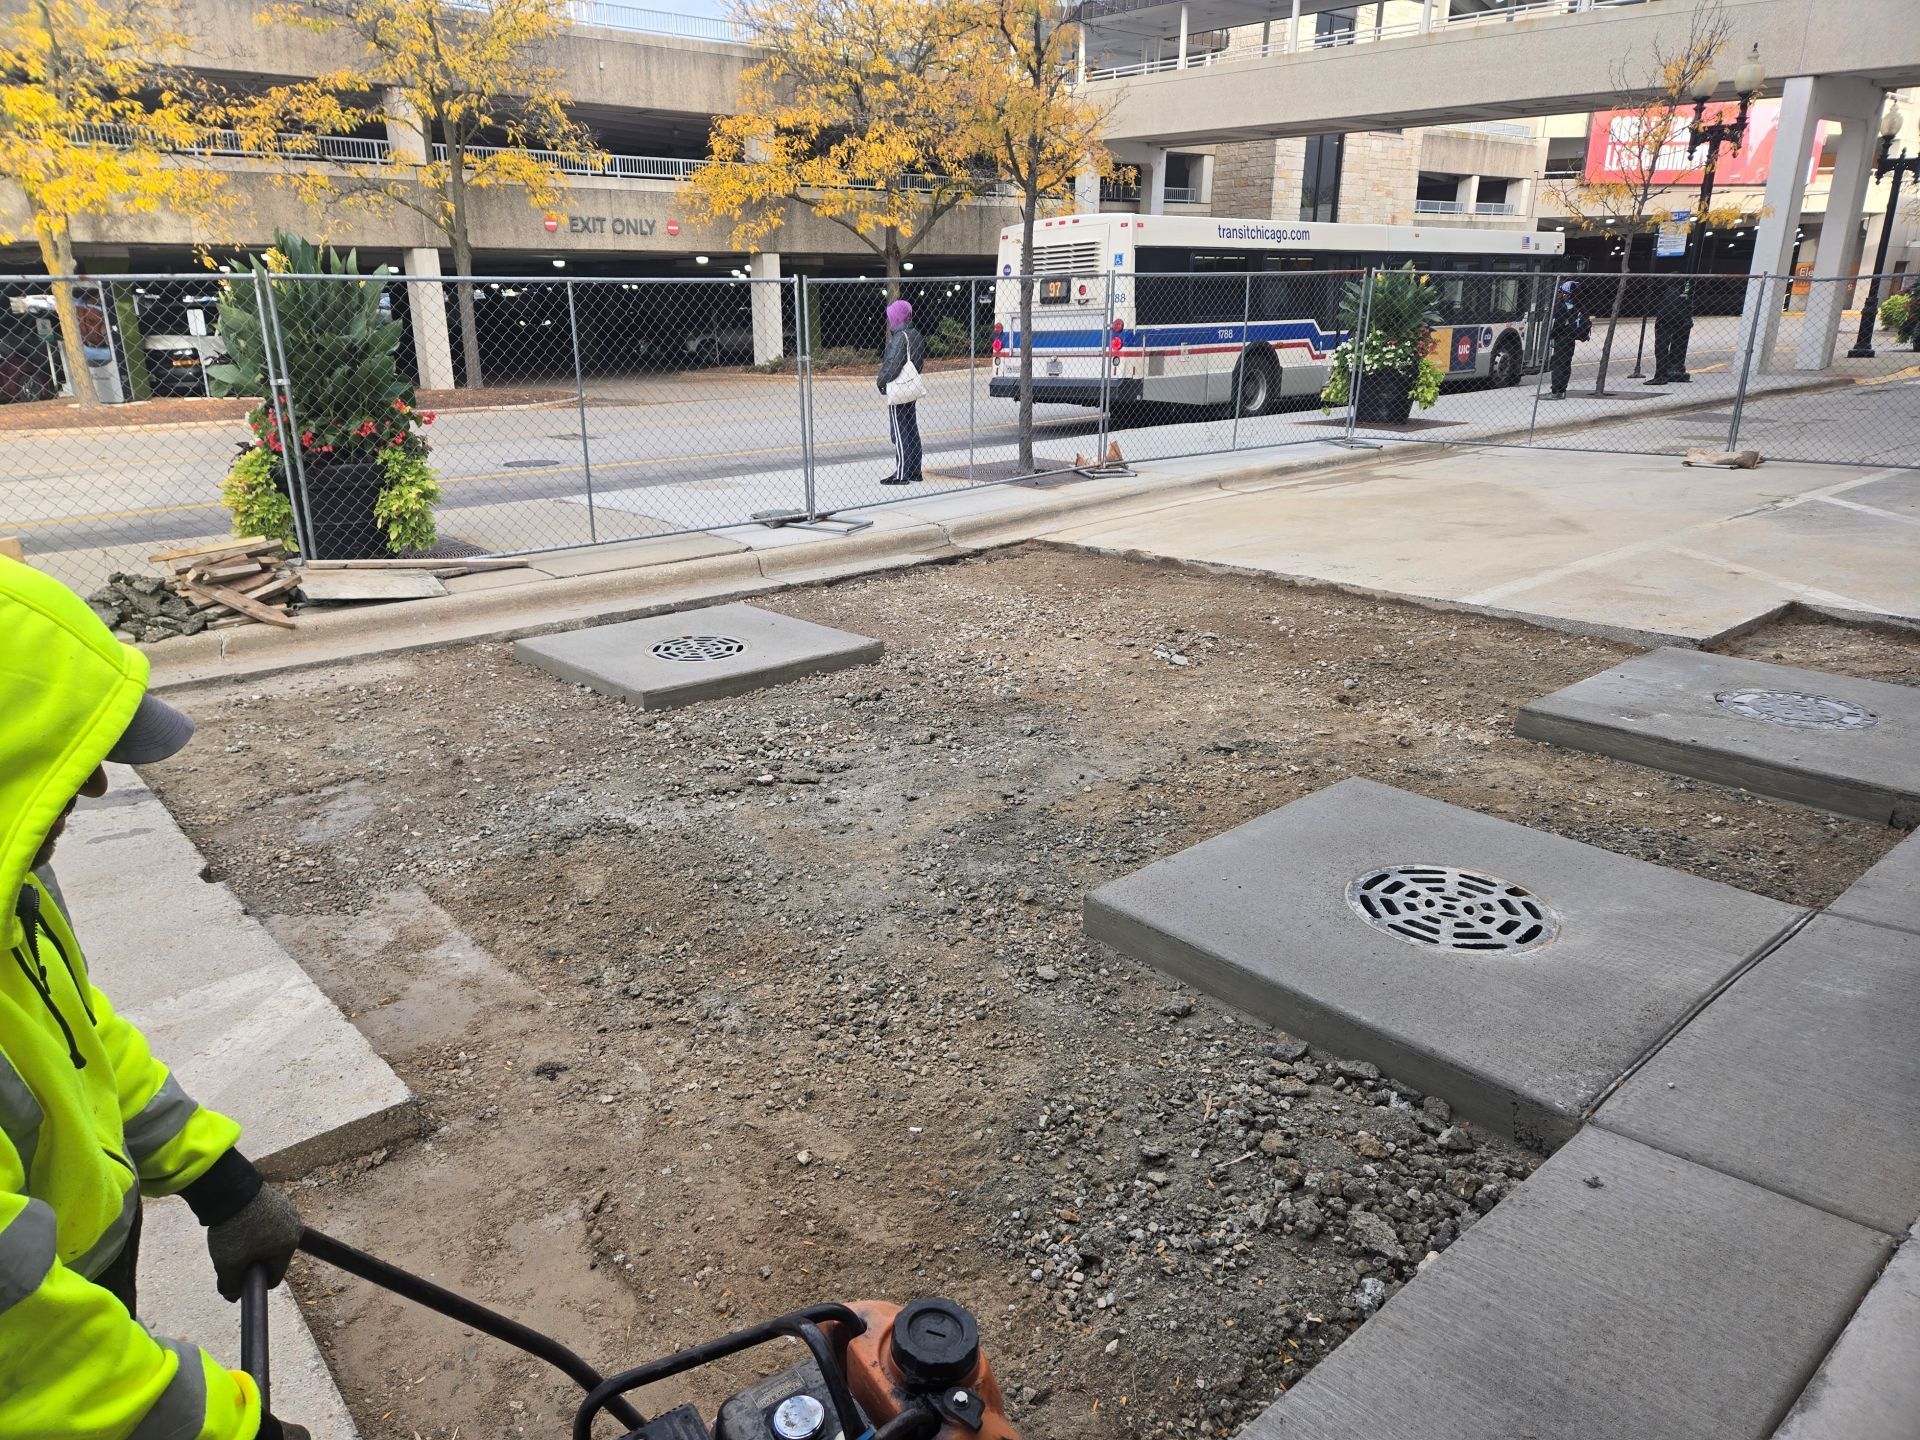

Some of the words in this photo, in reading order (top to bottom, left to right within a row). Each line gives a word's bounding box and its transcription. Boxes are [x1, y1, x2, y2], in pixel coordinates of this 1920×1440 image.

[569, 216, 606, 233] EXIT
[612, 218, 656, 235] ONLY
[1217, 224, 1311, 243] transitchicago.com
[1048, 281, 1062, 297] 97
[1218, 329, 1233, 339] 1788
[1458, 345, 1470, 354] UIC
